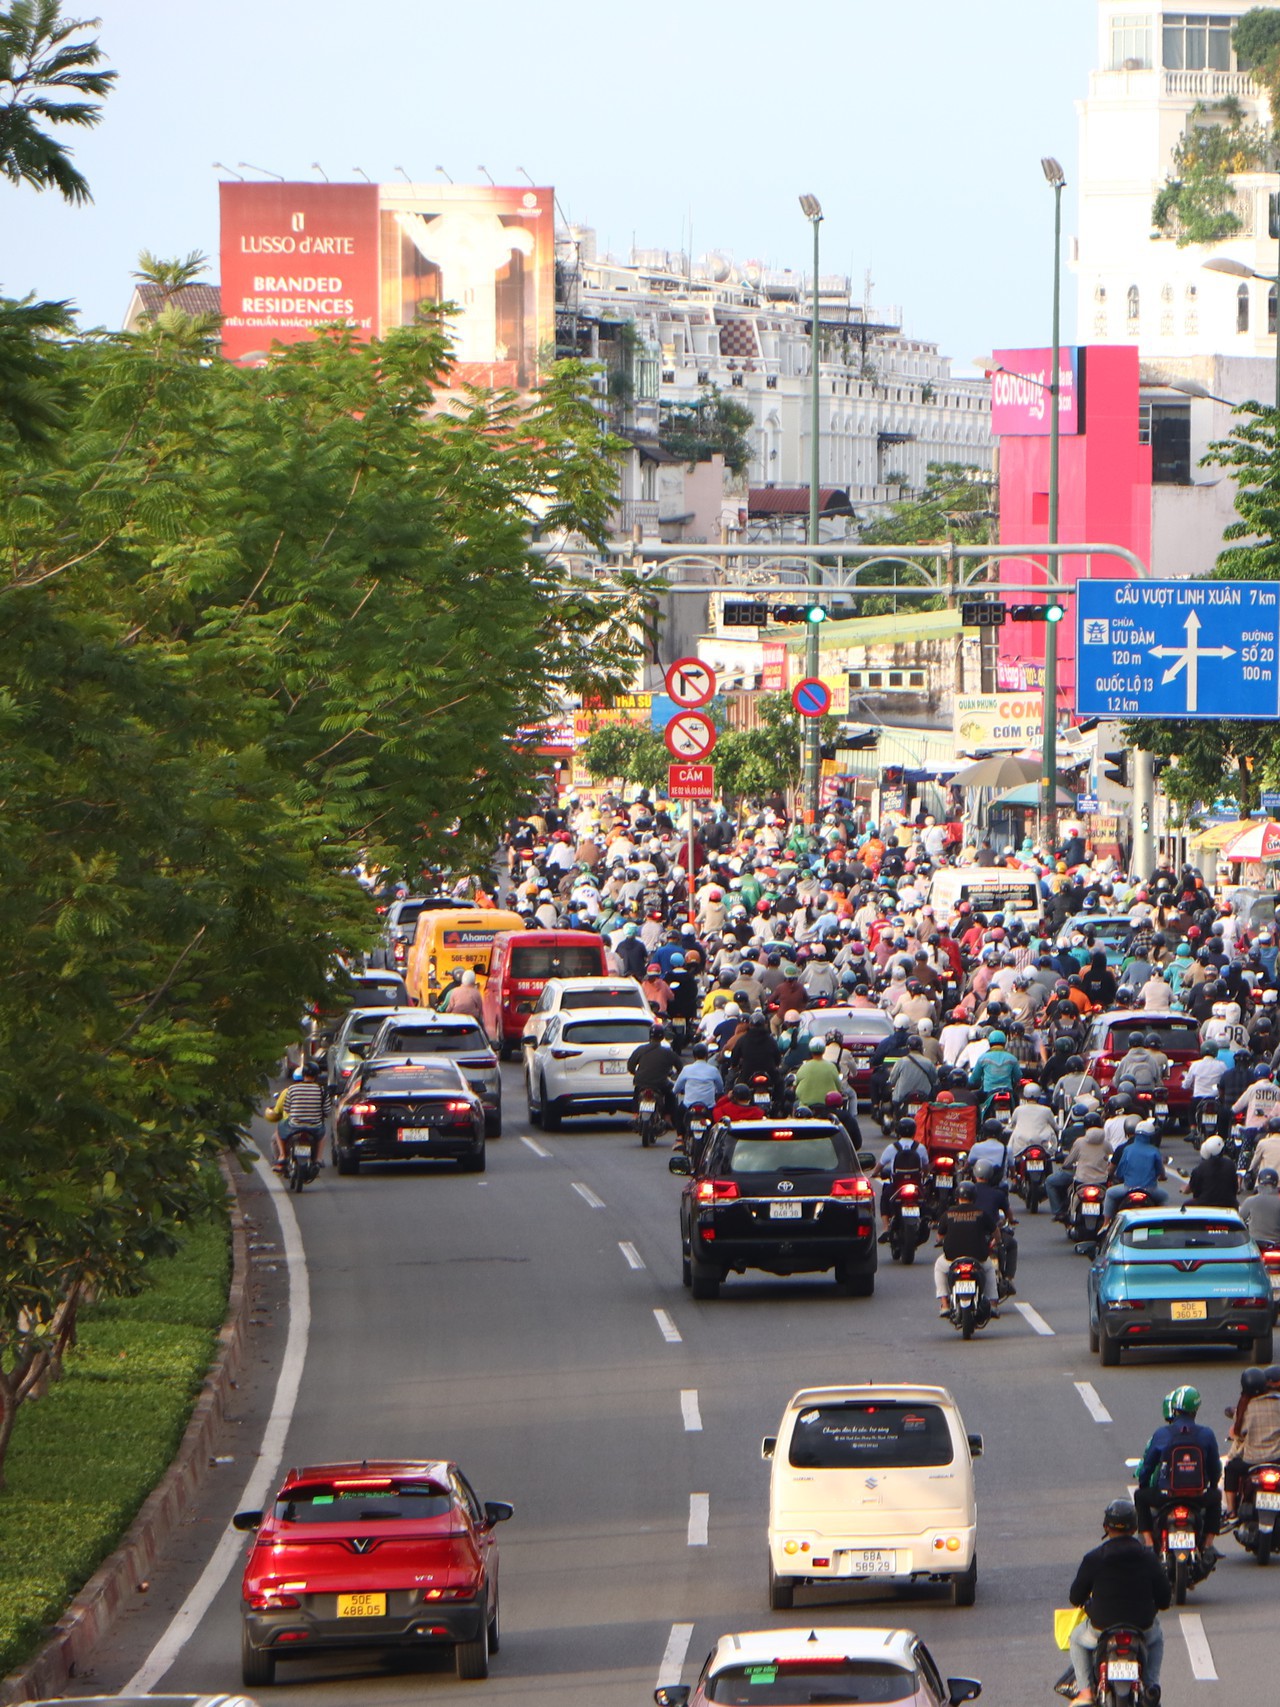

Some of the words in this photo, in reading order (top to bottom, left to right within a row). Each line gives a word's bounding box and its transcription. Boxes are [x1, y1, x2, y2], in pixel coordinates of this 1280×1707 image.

[241, 236, 295, 254] LUSSO
[300, 236, 354, 254] d'ARTE
[254, 276, 342, 292] BRANDED
[242, 298, 354, 314] RESIDENCES
[1115, 583, 1140, 604] CẦU
[1142, 587, 1174, 608] VƯỢT
[1177, 590, 1205, 604] LINH
[1208, 586, 1241, 605] XUÂN
[1250, 590, 1257, 605] 7
[1259, 590, 1276, 605] km
[1112, 631, 1129, 645] ƯU
[1130, 627, 1155, 645] ĐÀM
[1242, 630, 1274, 641] ĐƯỜNG
[1112, 651, 1130, 665] 120
[1132, 654, 1142, 665] m
[1242, 644, 1258, 662] SỐ
[1260, 648, 1274, 662] 20
[1242, 666, 1260, 680] 100
[1262, 670, 1272, 680] m
[1096, 673, 1125, 692] QUỐC
[1127, 675, 1142, 695] LỘ
[1144, 678, 1154, 691] 13
[1108, 698, 1121, 711] 1.2
[1122, 698, 1139, 711] km
[993, 724, 1022, 738] CƠM
[679, 766, 703, 781] CẤM
[1256, 1089, 1278, 1101] SICK
[352, 1596, 372, 1604] 50E
[344, 1606, 380, 1616] 488.05
